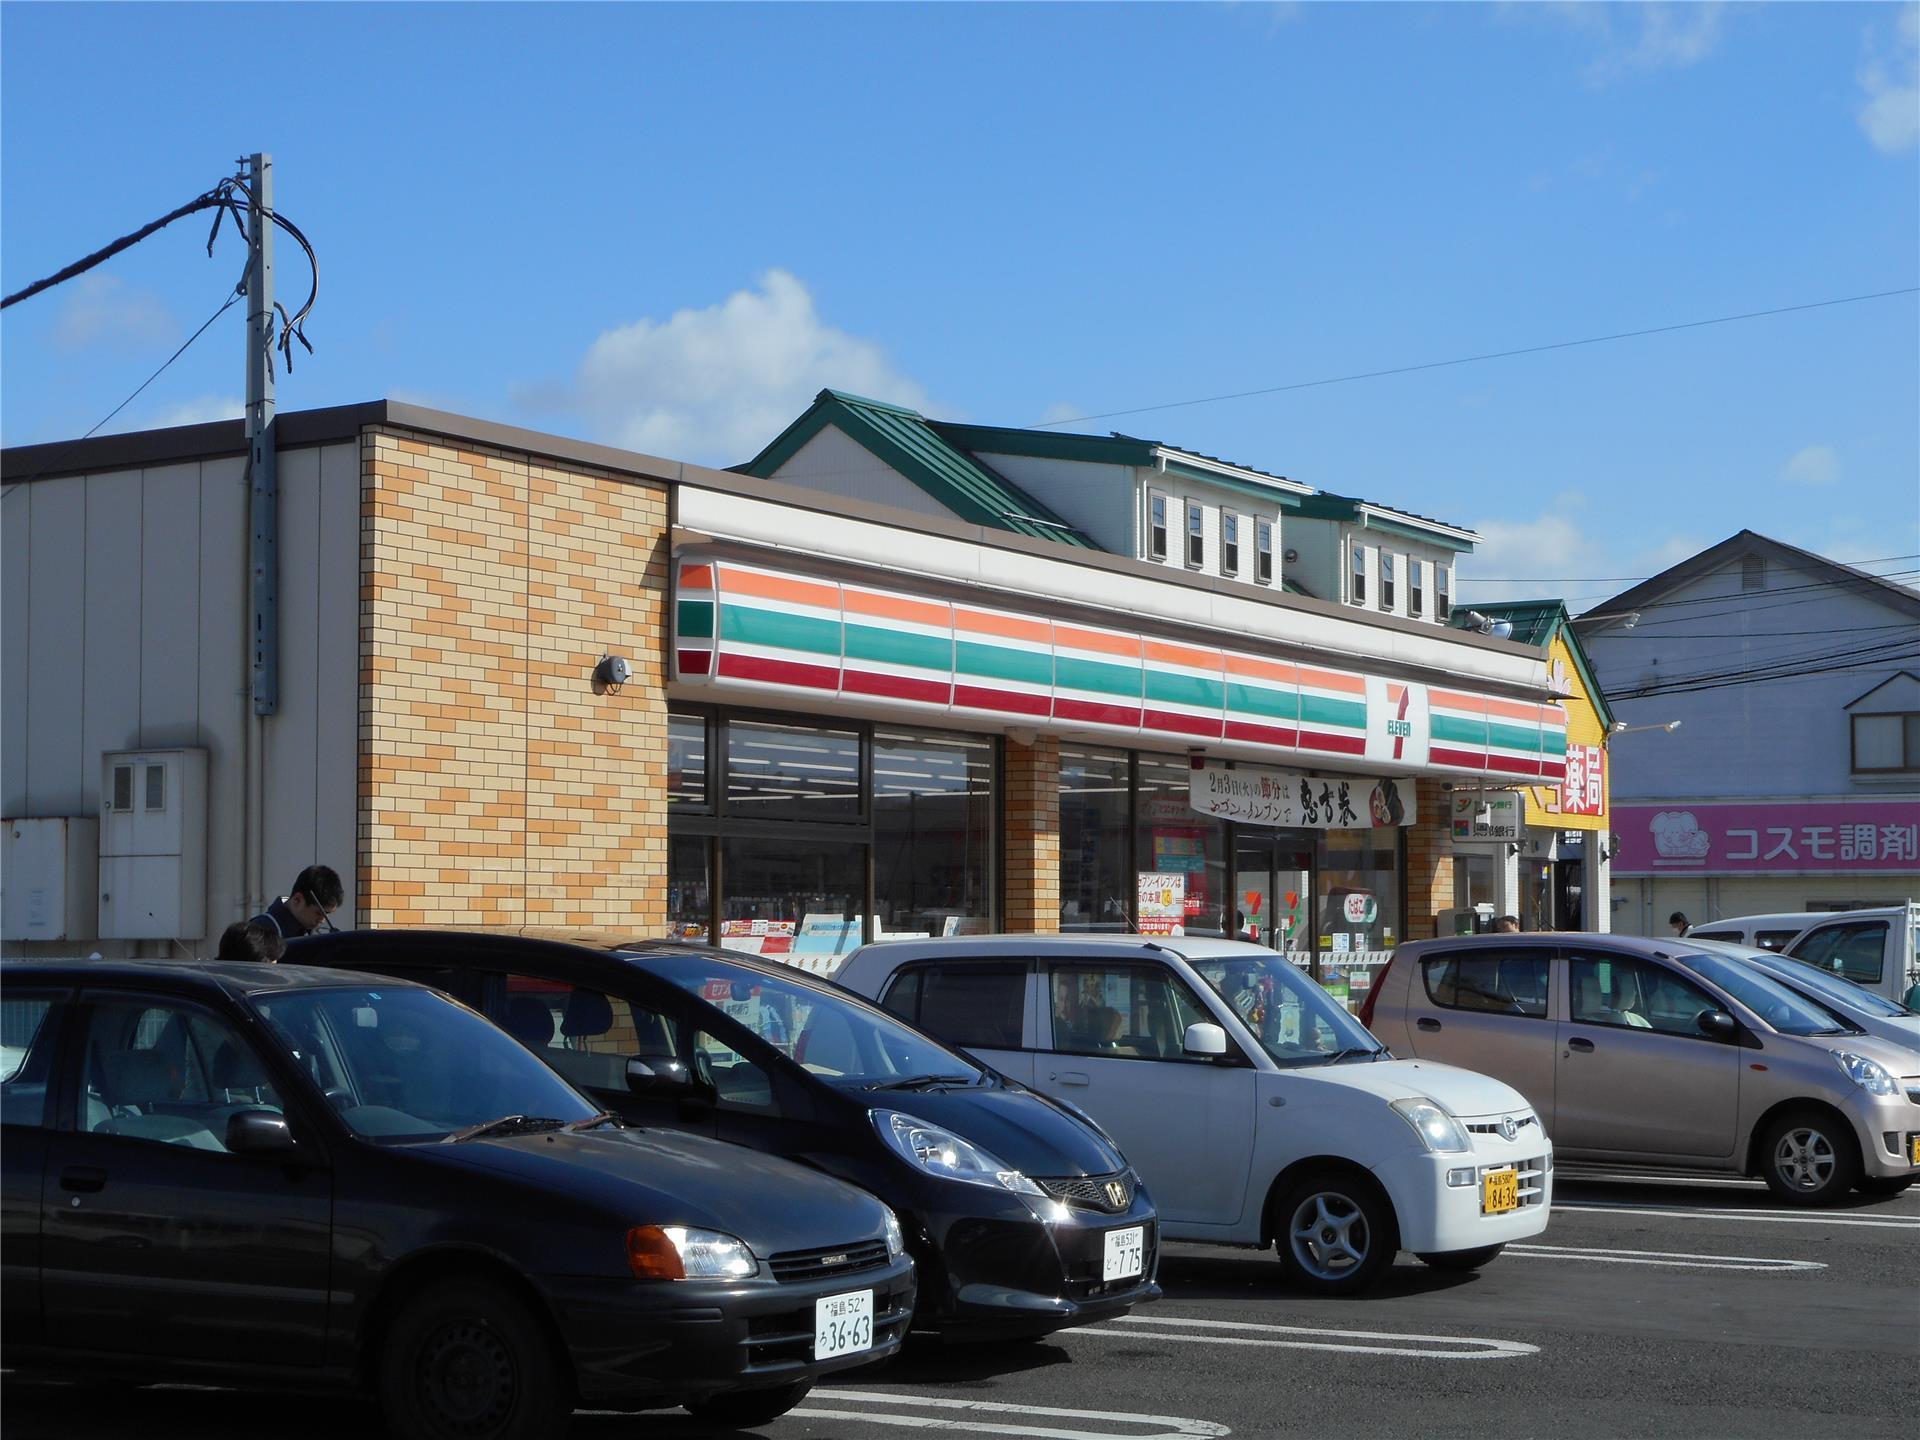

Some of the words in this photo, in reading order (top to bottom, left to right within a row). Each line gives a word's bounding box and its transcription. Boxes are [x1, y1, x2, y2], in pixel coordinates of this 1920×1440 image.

[1565, 743, 1604, 816] 薬局
[1726, 824, 1919, 861] コスモ調剤
[1114, 1235, 1126, 1247] 福島
[1126, 1232, 1135, 1246] 531
[830, 1301, 846, 1317] 福島
[848, 1297, 860, 1314] 52
[829, 1315, 870, 1352] 36-63
